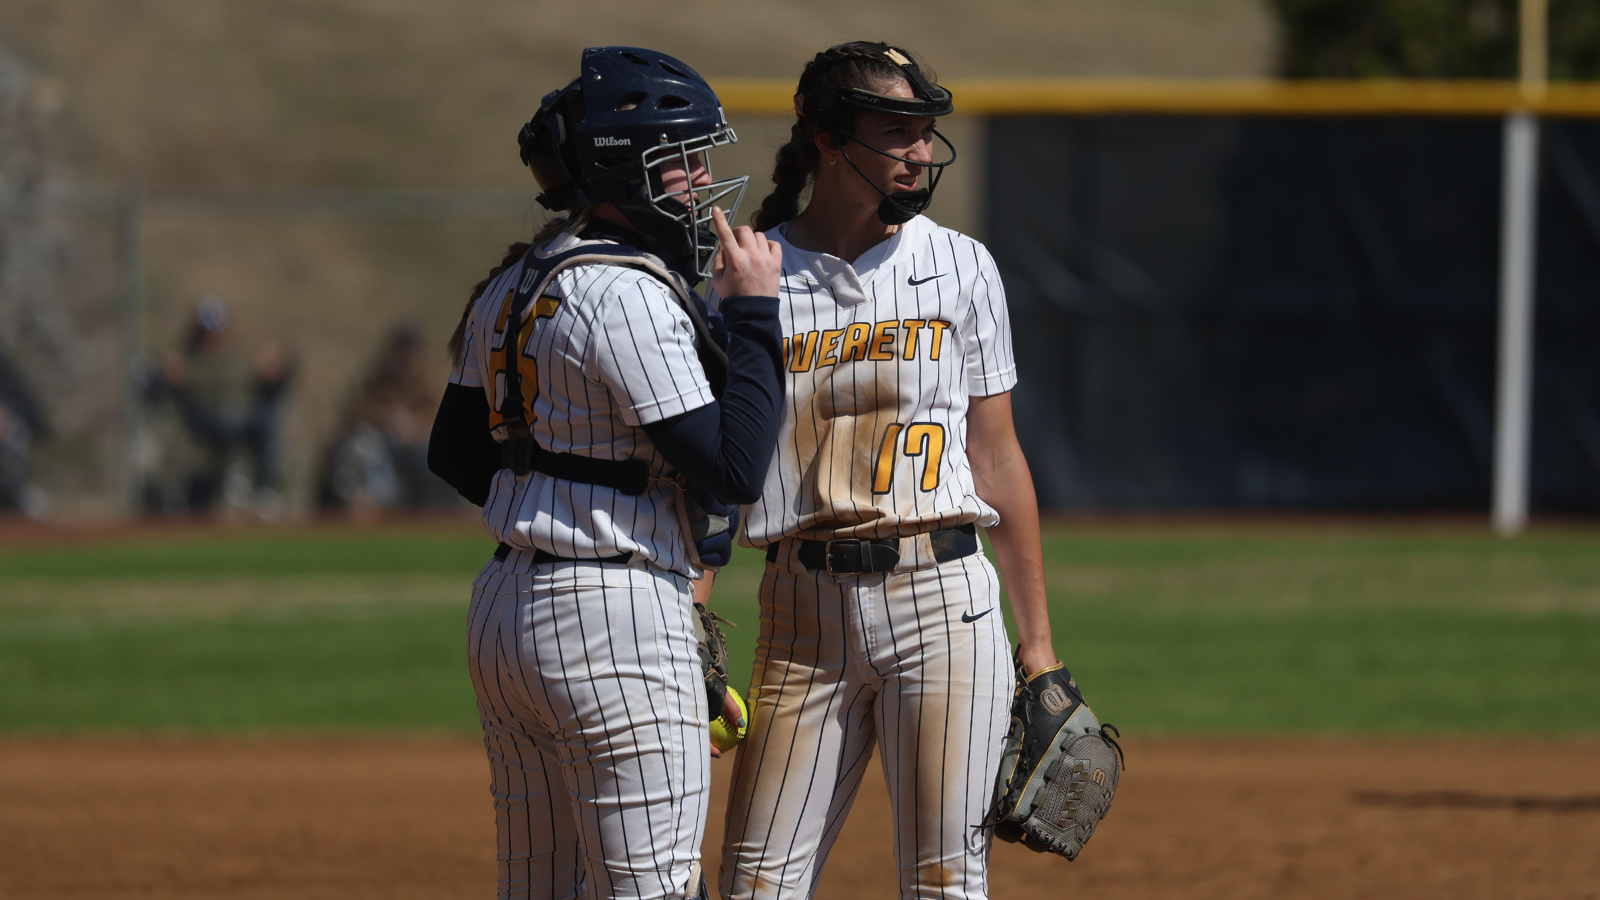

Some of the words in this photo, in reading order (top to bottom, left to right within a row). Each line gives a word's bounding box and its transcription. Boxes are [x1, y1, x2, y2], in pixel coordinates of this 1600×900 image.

[852, 93, 881, 104] RIP-IT
[593, 136, 632, 147] Wilson
[783, 319, 951, 374] VERETT
[871, 422, 946, 495] 17
